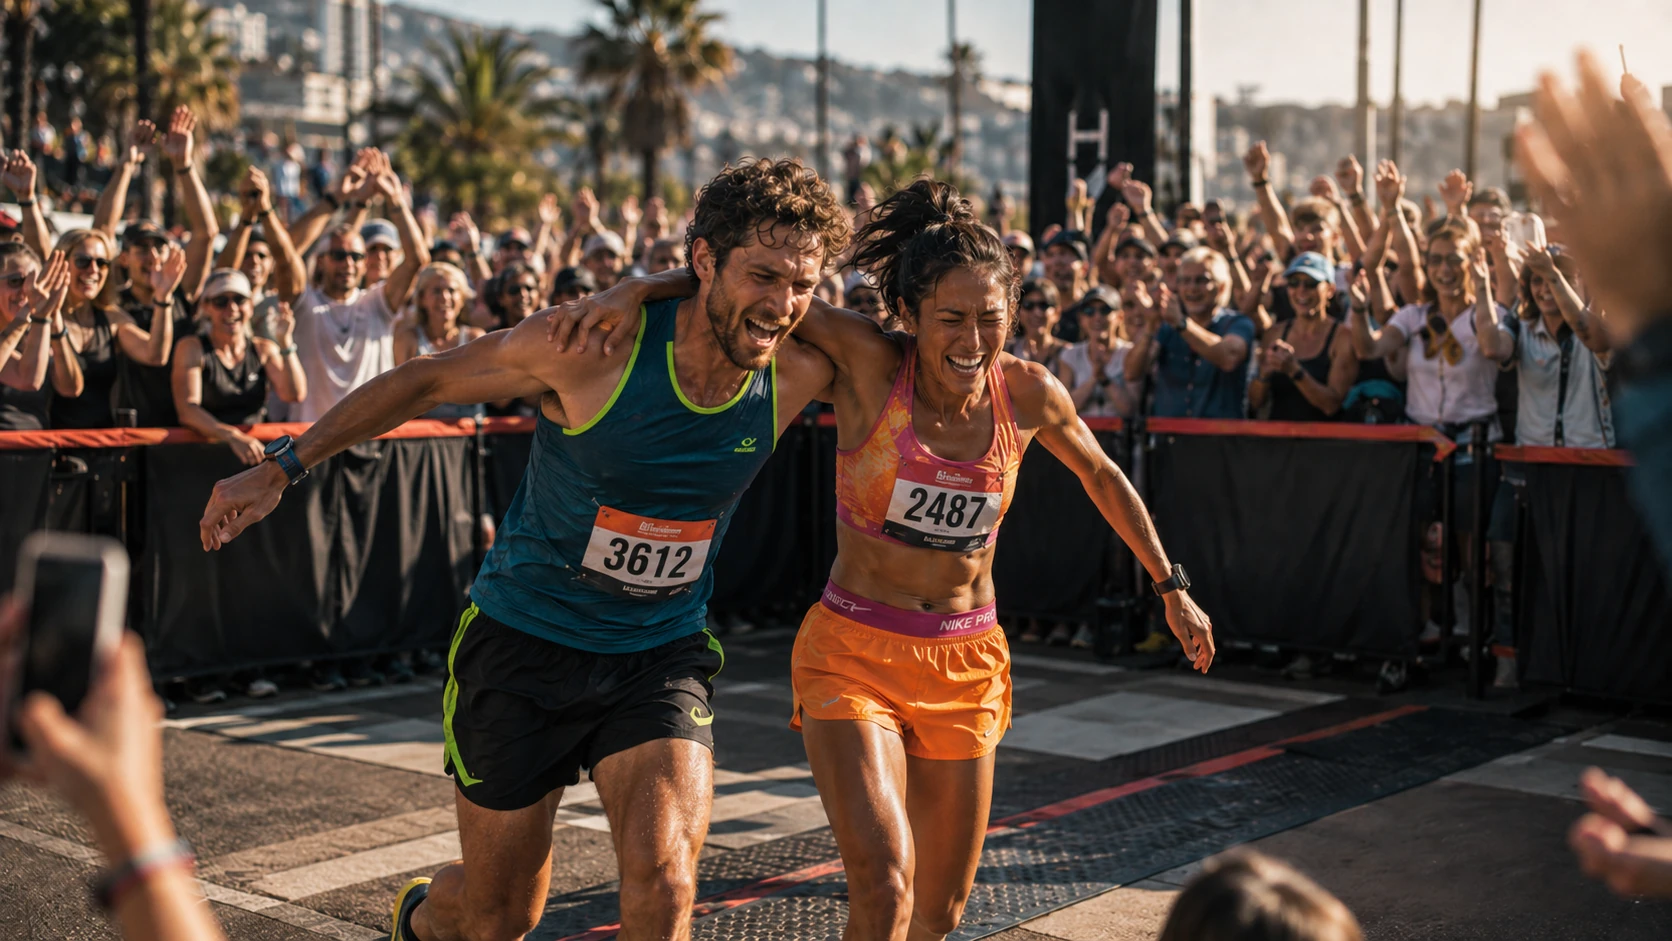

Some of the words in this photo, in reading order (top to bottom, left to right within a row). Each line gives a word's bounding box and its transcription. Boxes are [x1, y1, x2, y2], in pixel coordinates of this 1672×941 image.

[903, 487, 988, 530] 2487
[603, 537, 693, 579] 3612
[939, 616, 974, 631] NIKE
[975, 608, 996, 626] PRO
